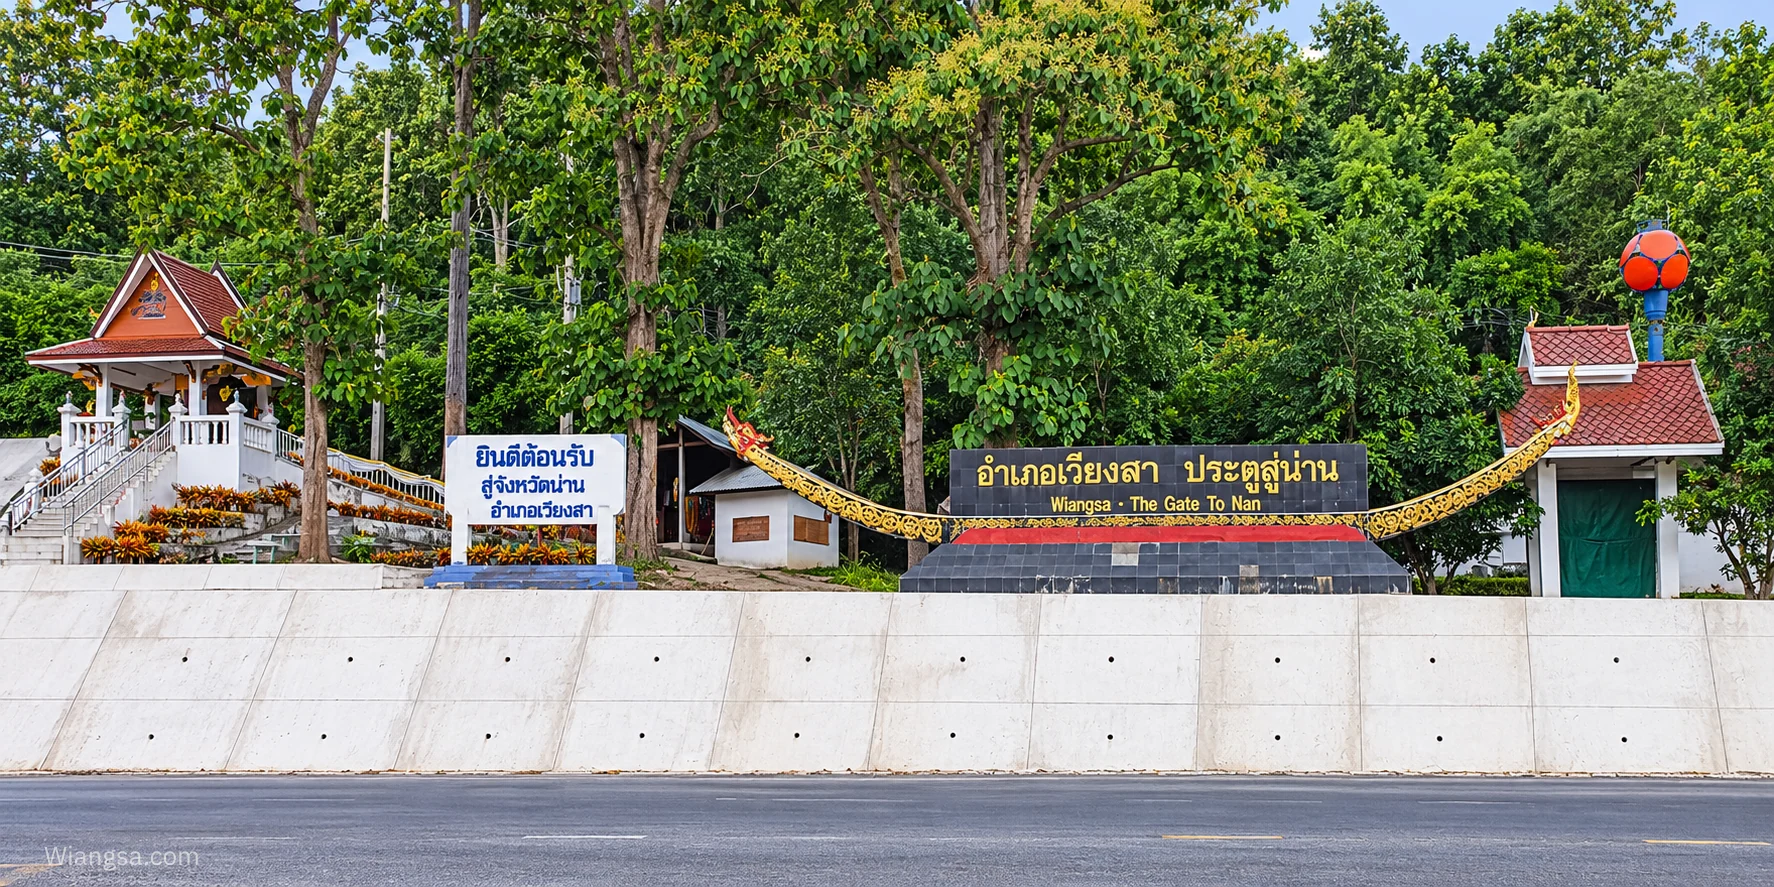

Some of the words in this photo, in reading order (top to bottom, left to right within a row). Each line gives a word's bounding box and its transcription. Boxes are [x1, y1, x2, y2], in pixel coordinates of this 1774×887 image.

[977, 452, 1159, 487] อำเภอเวียงสา
[1183, 450, 1339, 494] ประตูสู่น่าน
[481, 474, 585, 499] สู่จังหวัดน่าน
[490, 500, 593, 518] อำเภอเวียงสา
[1051, 496, 1111, 515] Wiangsa
[1130, 496, 1158, 512] The
[1164, 495, 1200, 512] Gate
[1207, 495, 1225, 512] To
[1231, 495, 1261, 511] Nan
